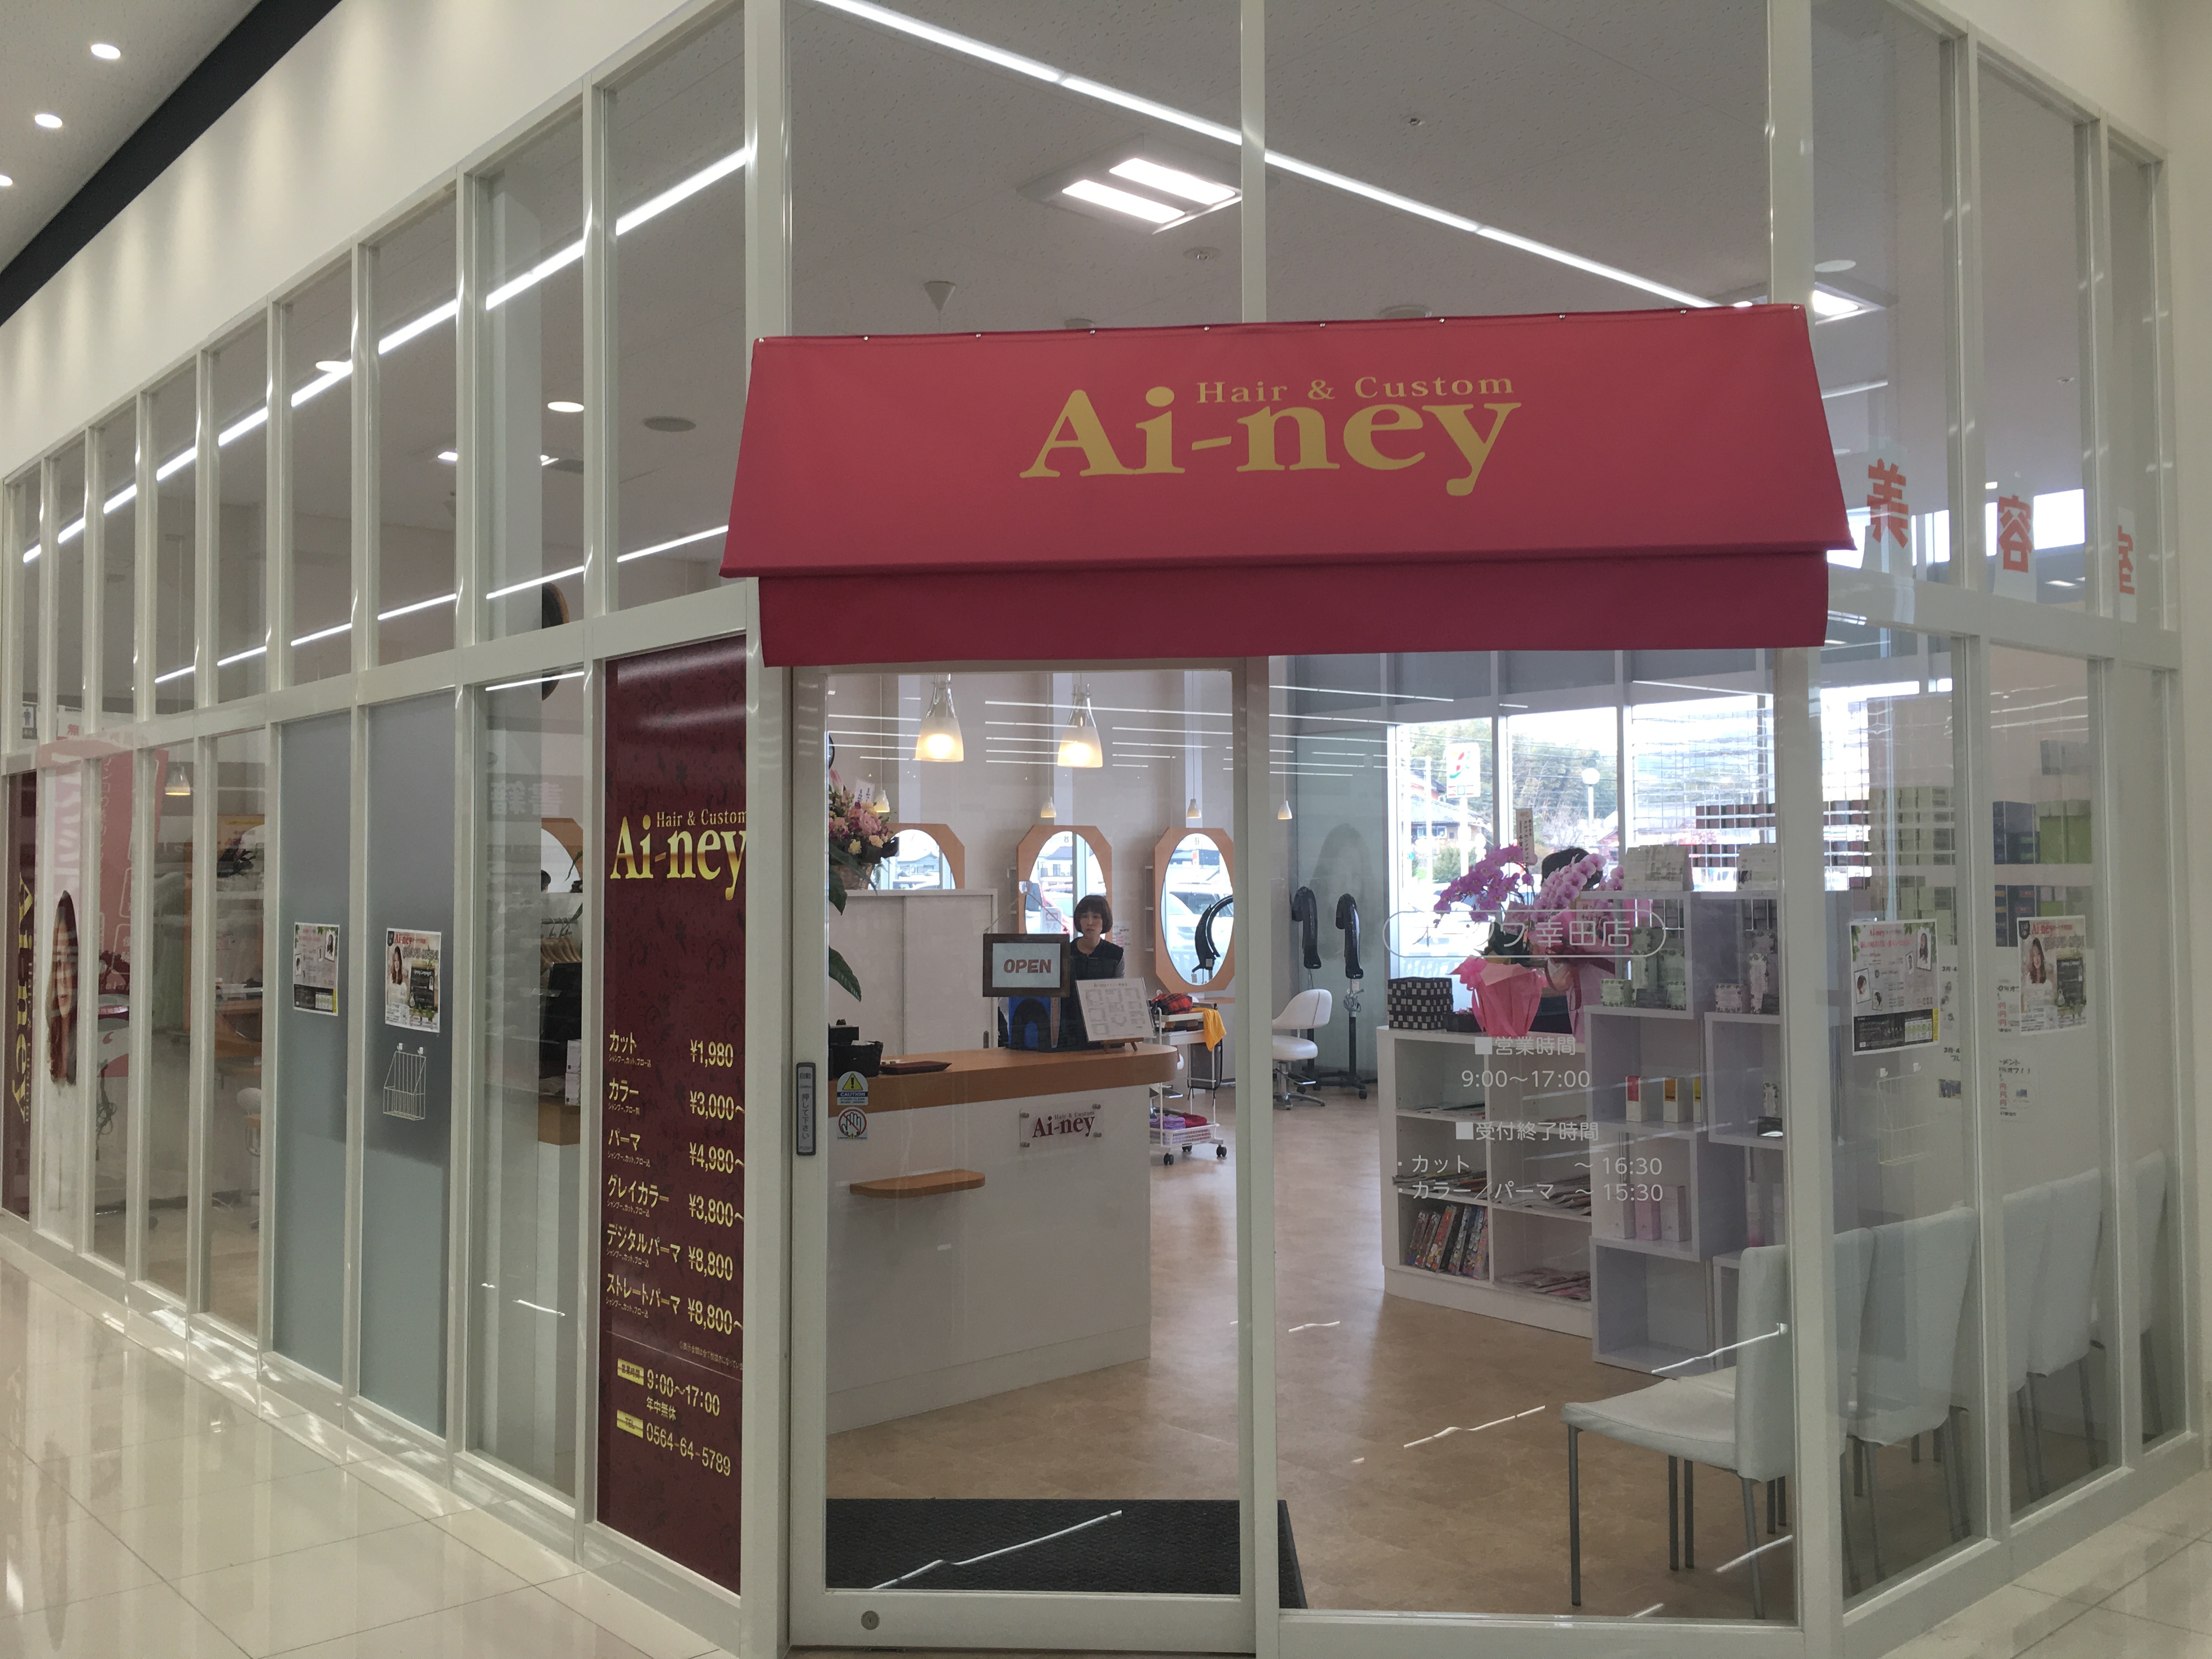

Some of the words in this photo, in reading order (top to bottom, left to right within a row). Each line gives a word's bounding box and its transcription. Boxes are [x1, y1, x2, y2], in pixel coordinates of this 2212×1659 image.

[1197, 382, 1288, 404] Hair
[1308, 379, 1335, 399] &
[1355, 376, 1515, 399] Custom
[1019, 386, 1522, 496] Ai-ney
[657, 812, 683, 828] Hair
[687, 810, 696, 826] &
[610, 815, 746, 900] Ai-ney
[1003, 958, 1052, 974] OPEN
[610, 1030, 637, 1054] カット
[690, 1039, 733, 1068] ¥1,980
[1494, 1036, 1577, 1057] 営業時間
[609, 1077, 639, 1103] カラー
[1032, 1116, 1096, 1138] Ai-ney
[1476, 1120, 1599, 1142] 受付終了時間
[608, 1129, 641, 1152] パーマ
[1412, 1154, 1470, 1174] カット
[608, 1174, 670, 1208] グレイカラー
[607, 1223, 681, 1263] デジタルパーマ
[689, 1245, 733, 1281] ¥8,800
[606, 1273, 681, 1314] ストレートパーマ
[646, 1396, 676, 1421] 年中無休
[646, 1422, 731, 1477] 0564-64-5789
